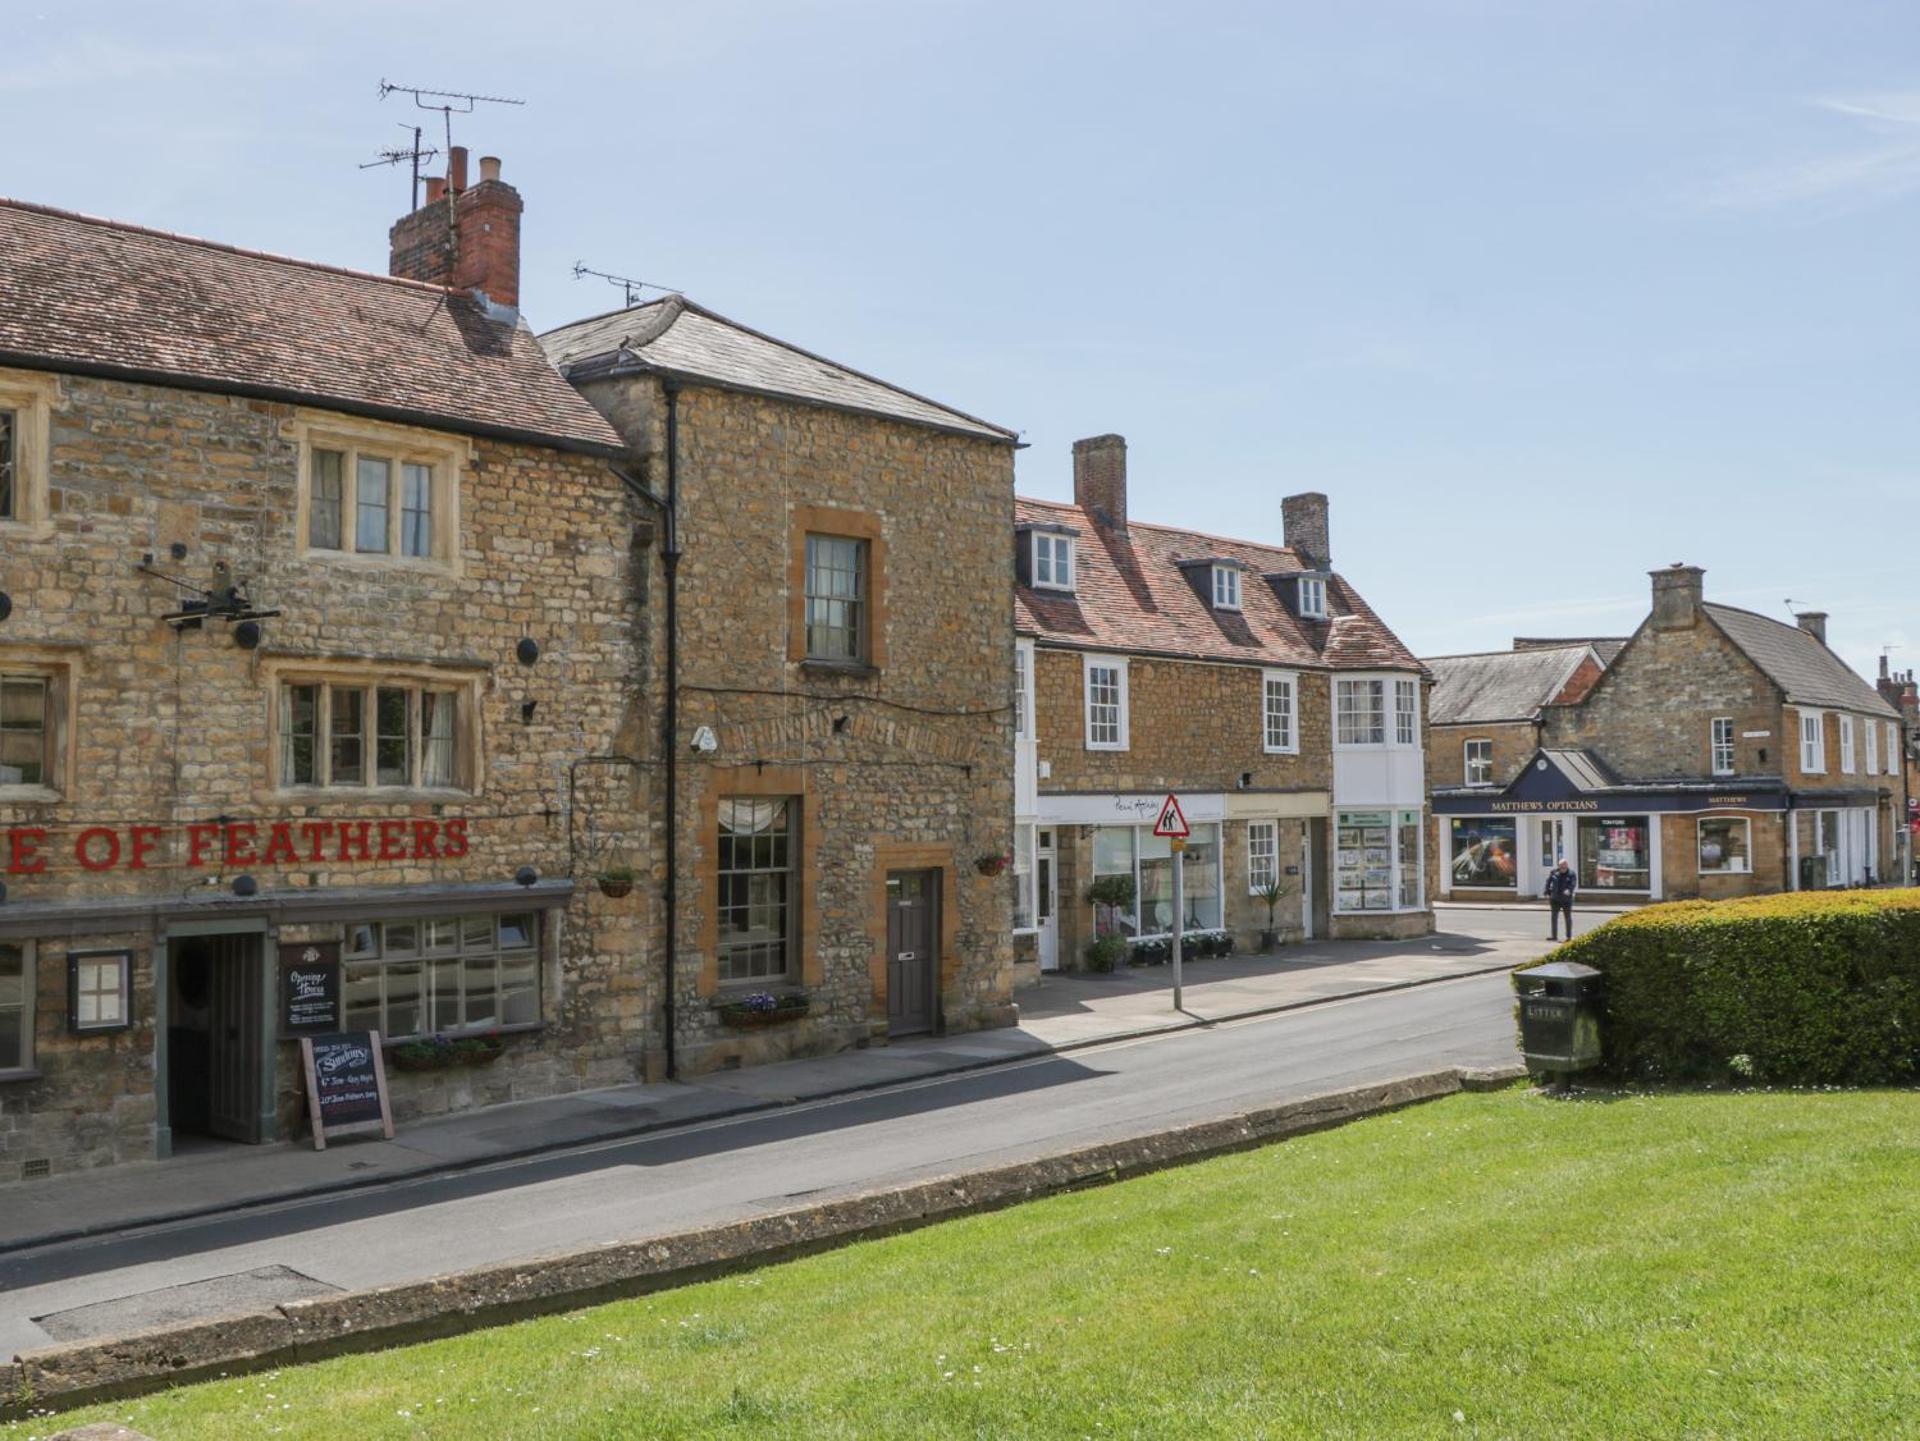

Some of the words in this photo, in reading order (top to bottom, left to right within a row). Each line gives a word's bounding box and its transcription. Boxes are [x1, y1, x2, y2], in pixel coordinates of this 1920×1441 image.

[1491, 801, 1543, 811] MATTHEWS
[1546, 800, 1598, 810] OPTICIANS
[8, 828, 46, 873] E
[75, 826, 161, 871] OF
[187, 818, 470, 867] FEATHERS
